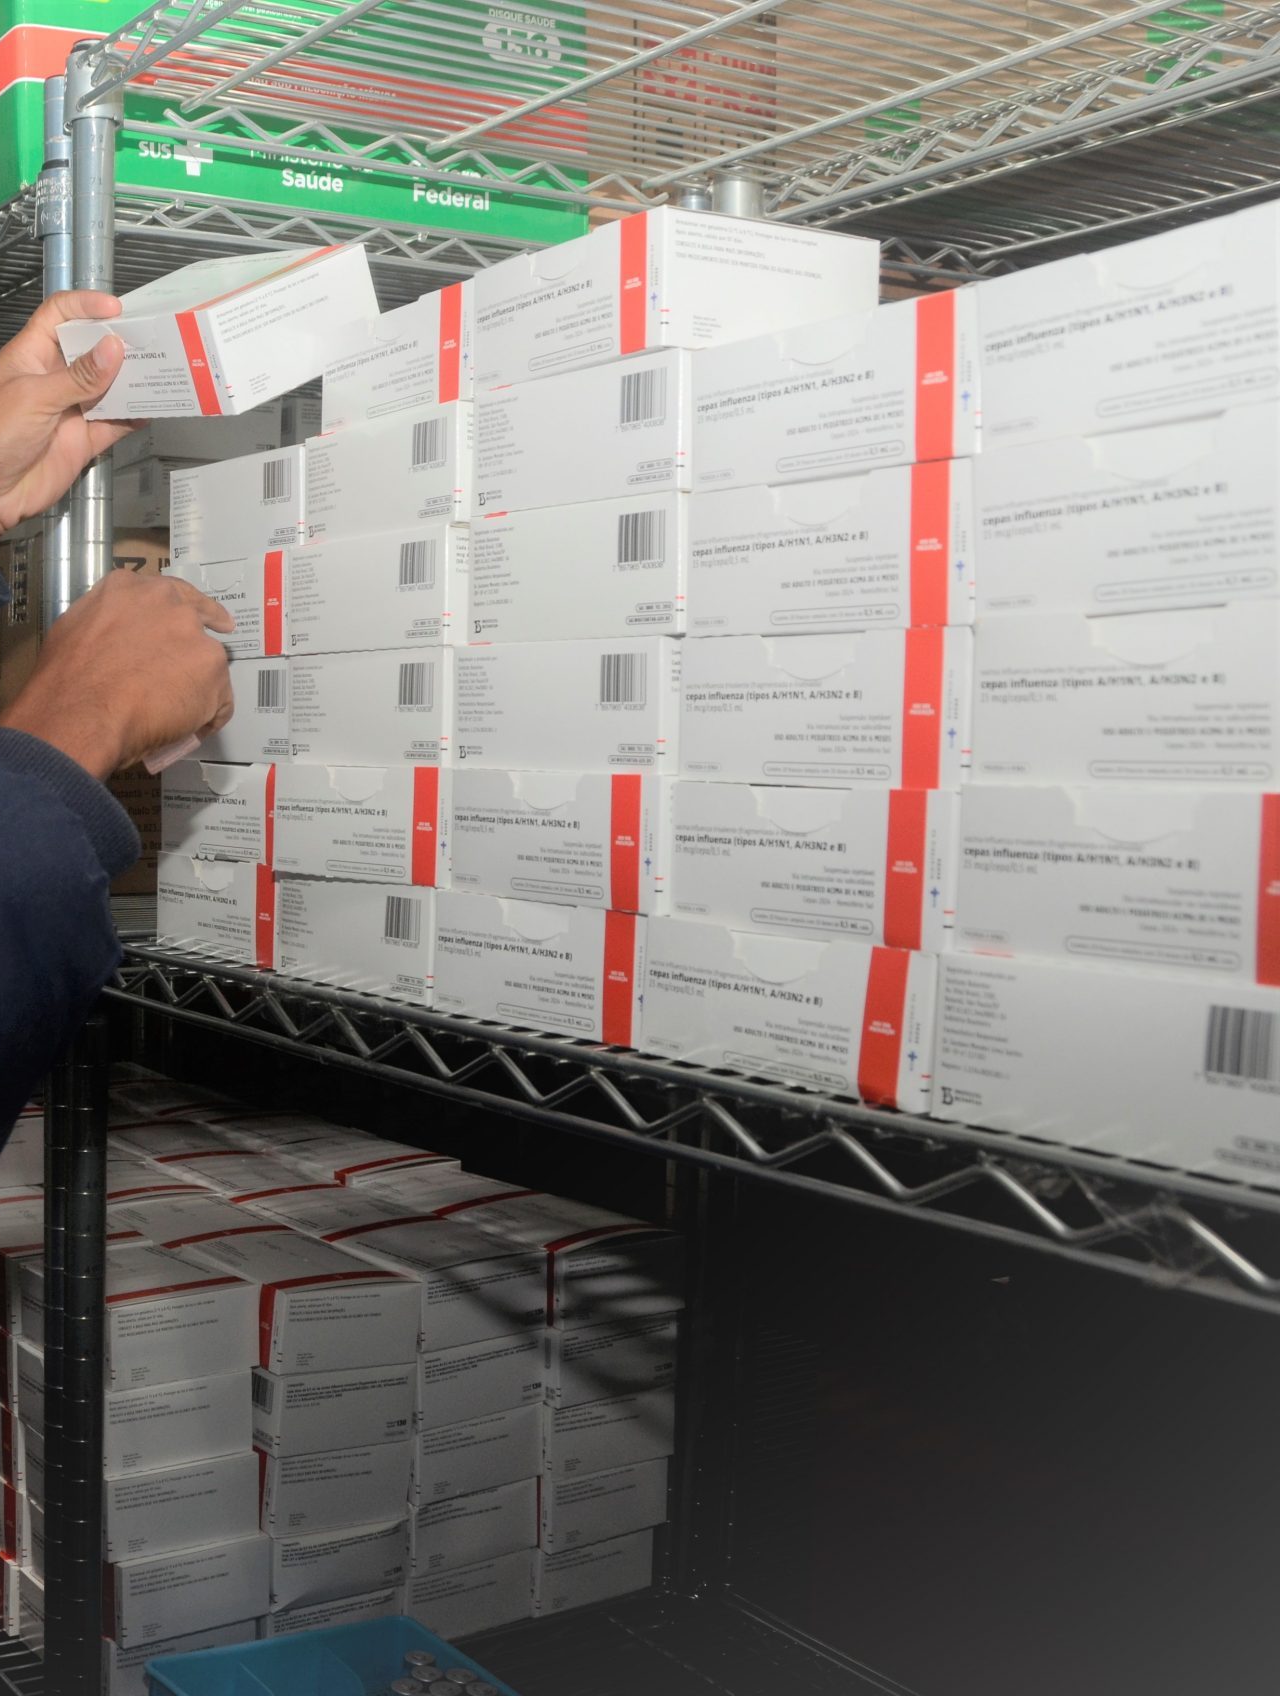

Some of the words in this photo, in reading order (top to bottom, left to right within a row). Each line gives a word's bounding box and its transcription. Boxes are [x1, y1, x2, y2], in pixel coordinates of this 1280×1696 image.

[138, 141, 172, 159] SUS
[282, 168, 343, 192] Saúde
[413, 183, 489, 211] Federal
[685, 694, 706, 702] cepas
[708, 692, 744, 700] influenza
[746, 691, 770, 702] (tipos
[809, 690, 844, 699] A/H3N2
[853, 690, 863, 700] B)
[675, 835, 695, 843] cepas
[697, 835, 732, 844] influenza
[733, 837, 756, 848] (tipos
[794, 841, 828, 851] A/H3N2
[837, 843, 847, 853] B)
[649, 970, 670, 981] cepas
[671, 972, 706, 986] influenza
[708, 978, 732, 992] (tipos
[770, 989, 804, 1003] A/H3N2
[814, 996, 823, 1007] B)
